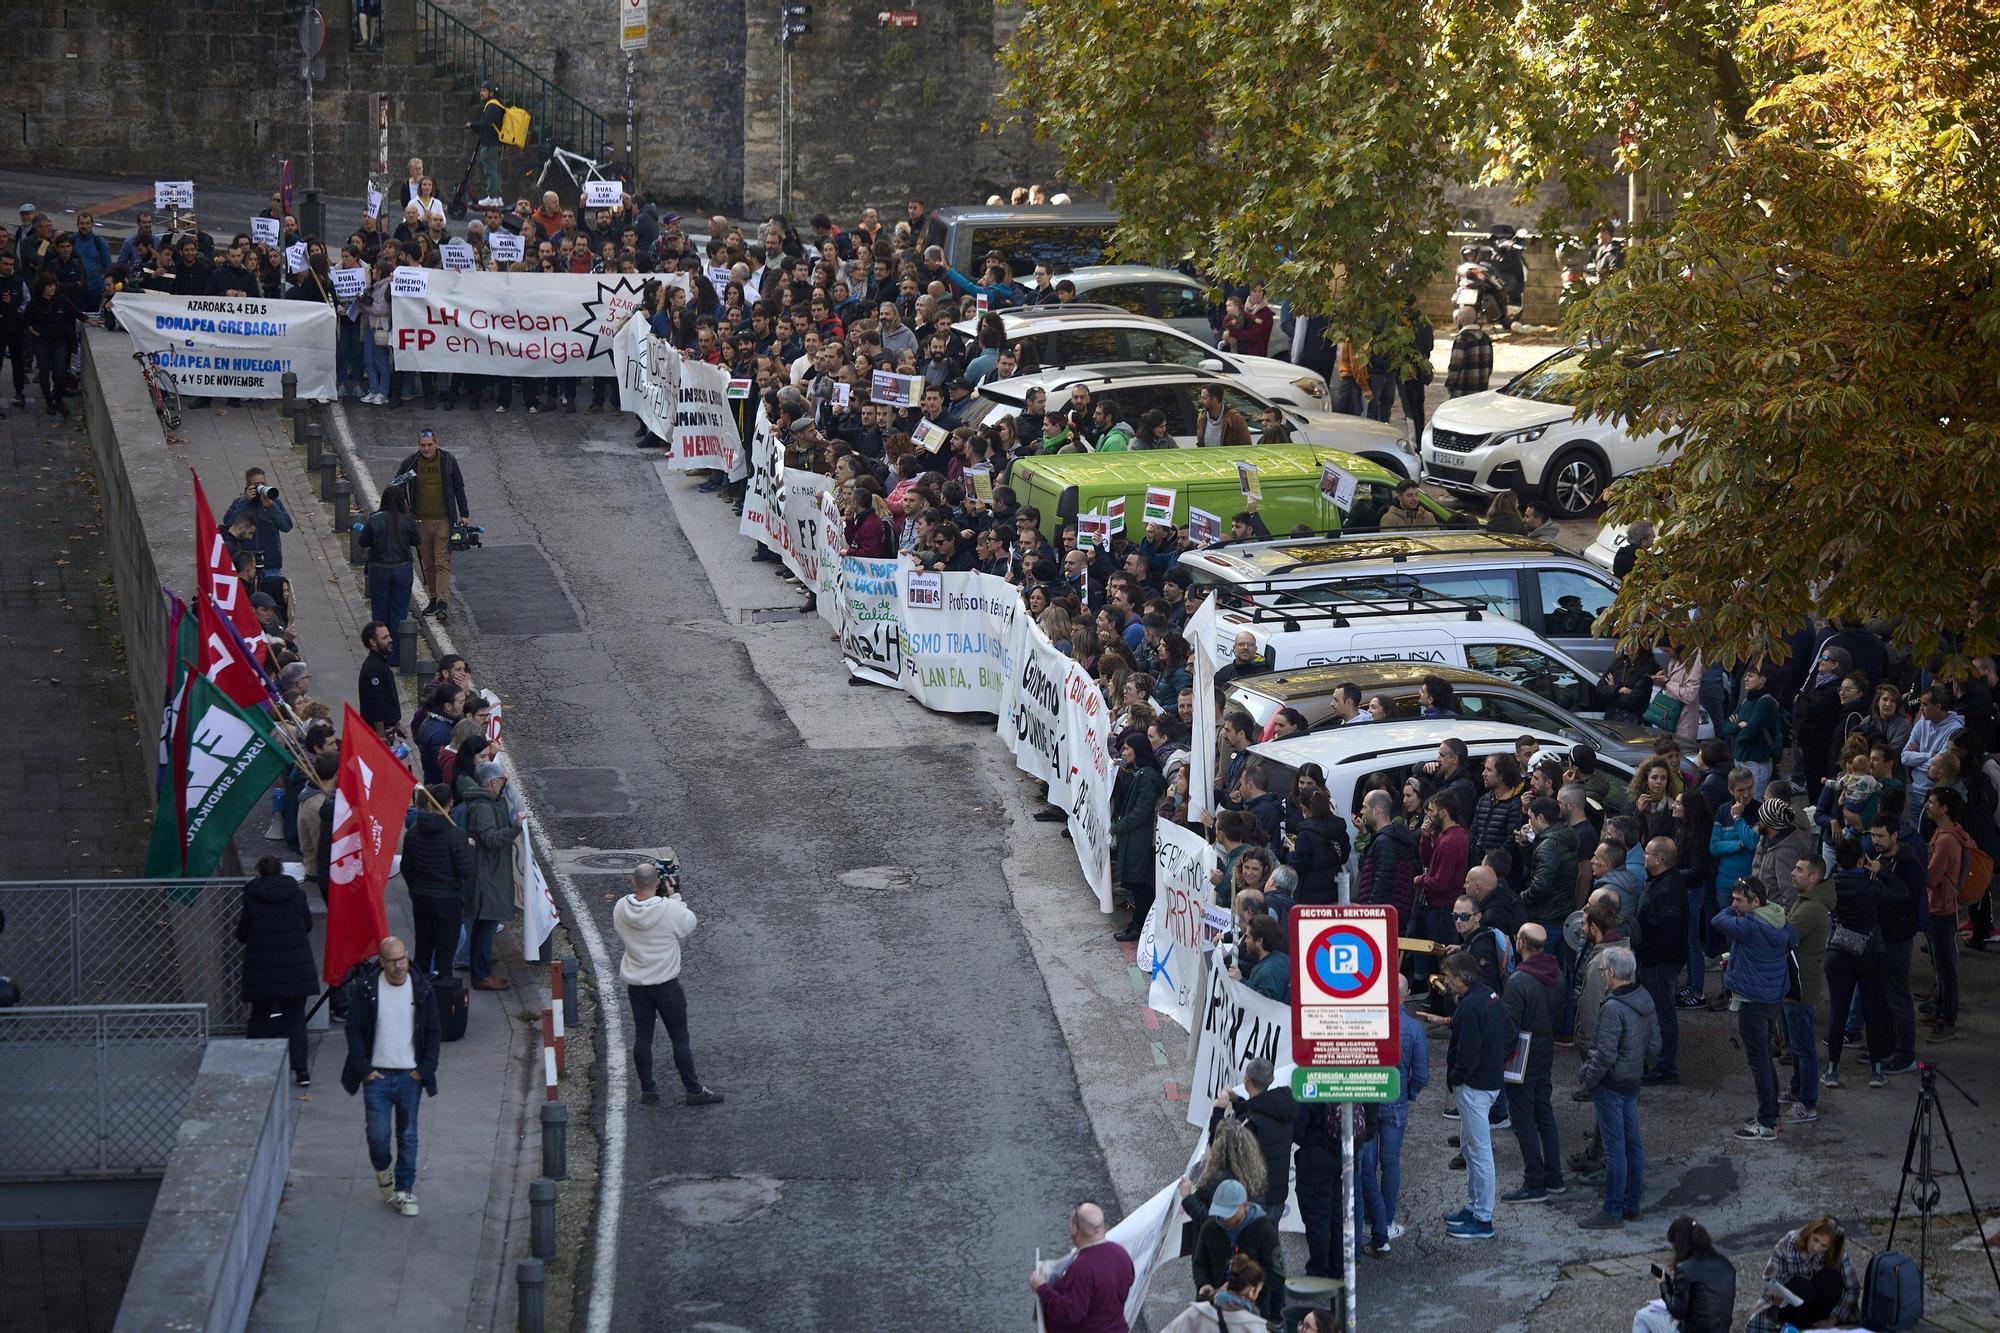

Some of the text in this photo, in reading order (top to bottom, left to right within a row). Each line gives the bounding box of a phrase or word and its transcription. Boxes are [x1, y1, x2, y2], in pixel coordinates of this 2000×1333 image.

[338, 275, 356, 283] DUAL
[187, 300, 227, 314] AZAROAK
[245, 303, 259, 314] ETA
[156, 315, 287, 337] DONAPEA GREBARA!!
[426, 306, 568, 332] LH Greban
[399, 328, 585, 364] FP en huelga
[153, 351, 211, 370] DONAPEA
[214, 356, 229, 370] EN
[181, 374, 187, 384] 4
[189, 375, 195, 384] Y
[197, 374, 203, 385] 5
[205, 375, 215, 385] DE
[216, 374, 264, 387] NOVIEMBRE
[1300, 908, 1332, 917] SECTOR
[1343, 908, 1386, 917] SEKTOREA
